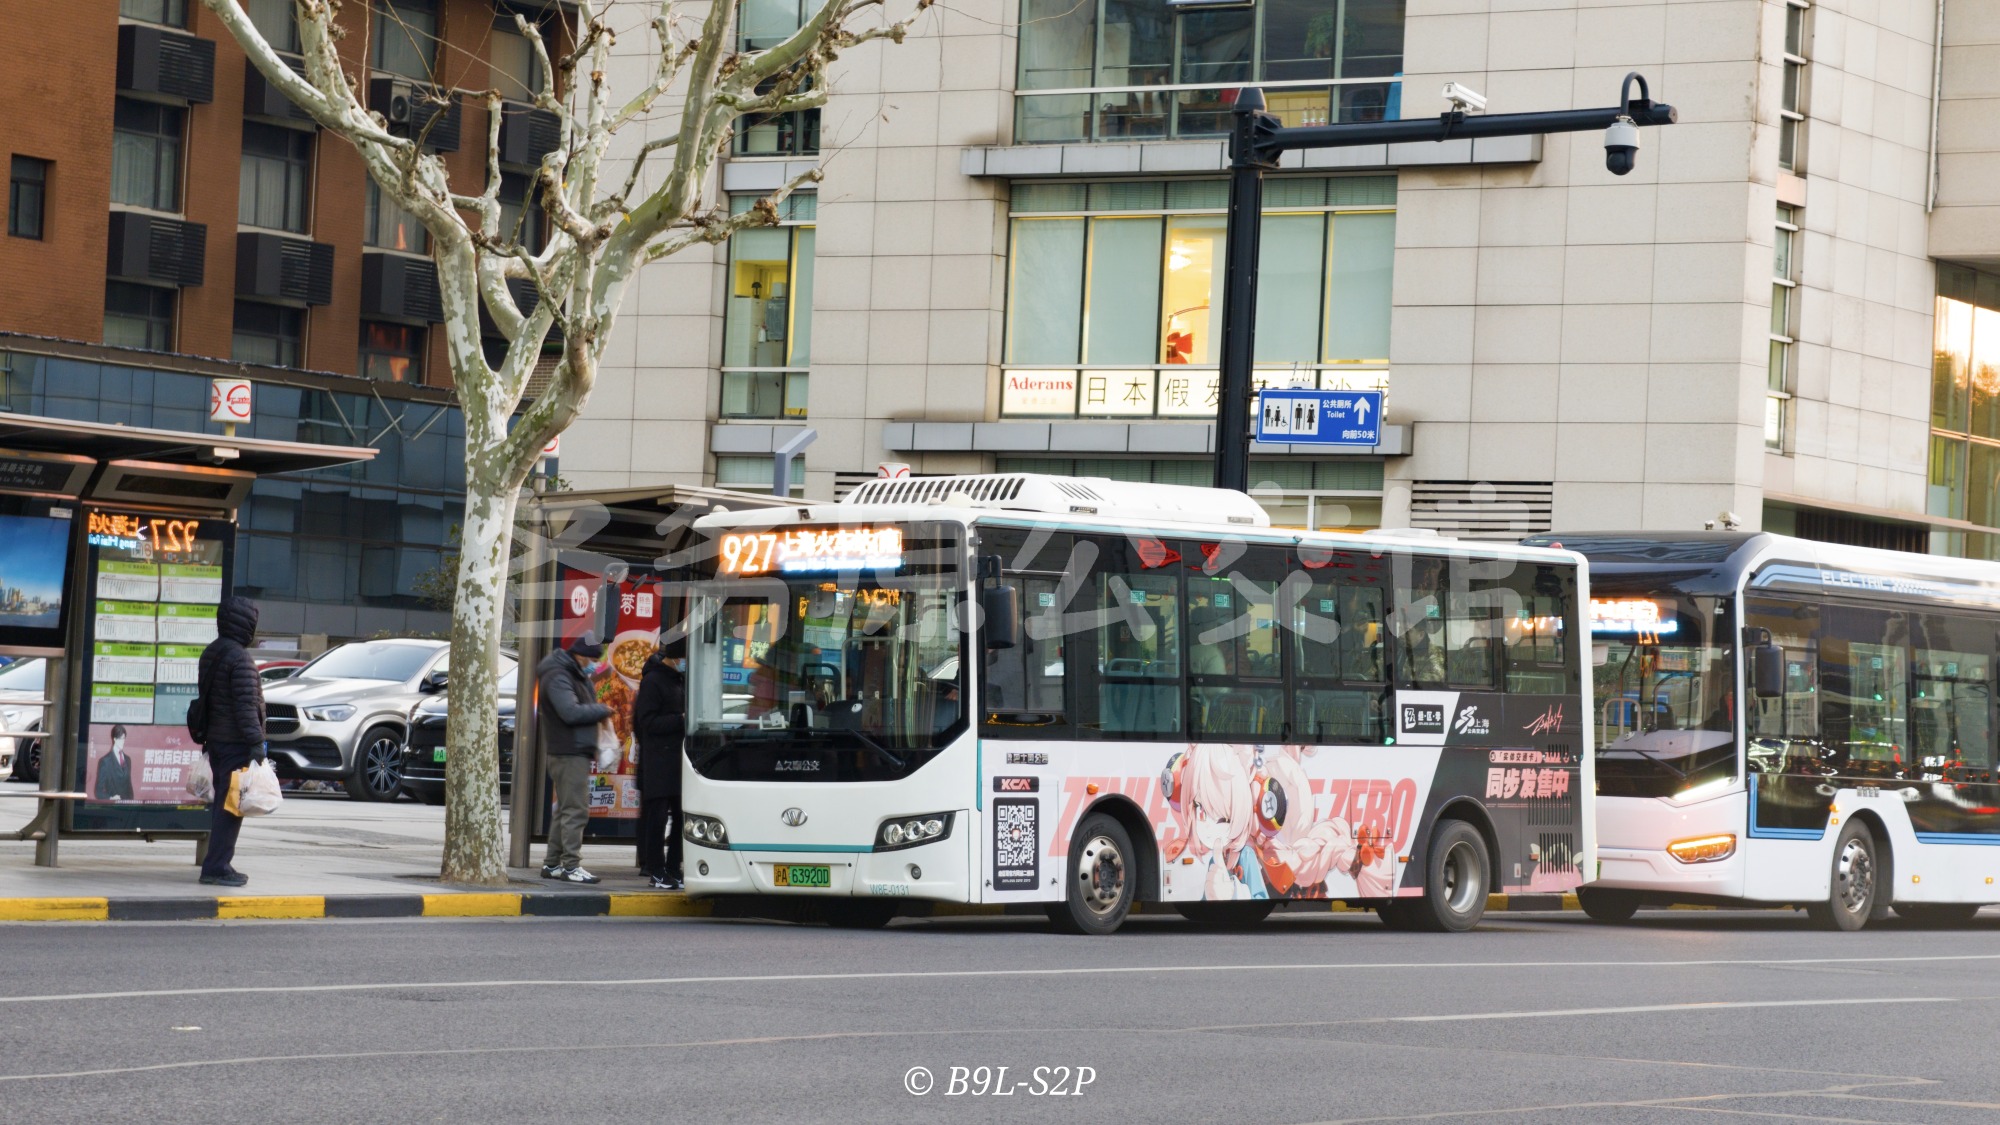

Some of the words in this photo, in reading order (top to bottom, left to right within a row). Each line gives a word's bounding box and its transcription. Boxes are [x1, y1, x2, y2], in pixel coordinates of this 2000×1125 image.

[1008, 376, 1074, 391] Aderans
[1322, 399, 1352, 409] 公共厕所
[1326, 410, 1345, 419] Toilet
[1342, 429, 1375, 440] 向前50米
[723, 534, 777, 573] 927
[1821, 570, 1890, 591] ELECTRIC
[1474, 718, 1490, 728] 上海
[1485, 767, 1570, 799] 同步发售中
[1328, 777, 1417, 854] ZERO
[775, 867, 788, 883] 沪A
[791, 868, 829, 884] 63920D
[869, 884, 910, 896] W8E-0131
